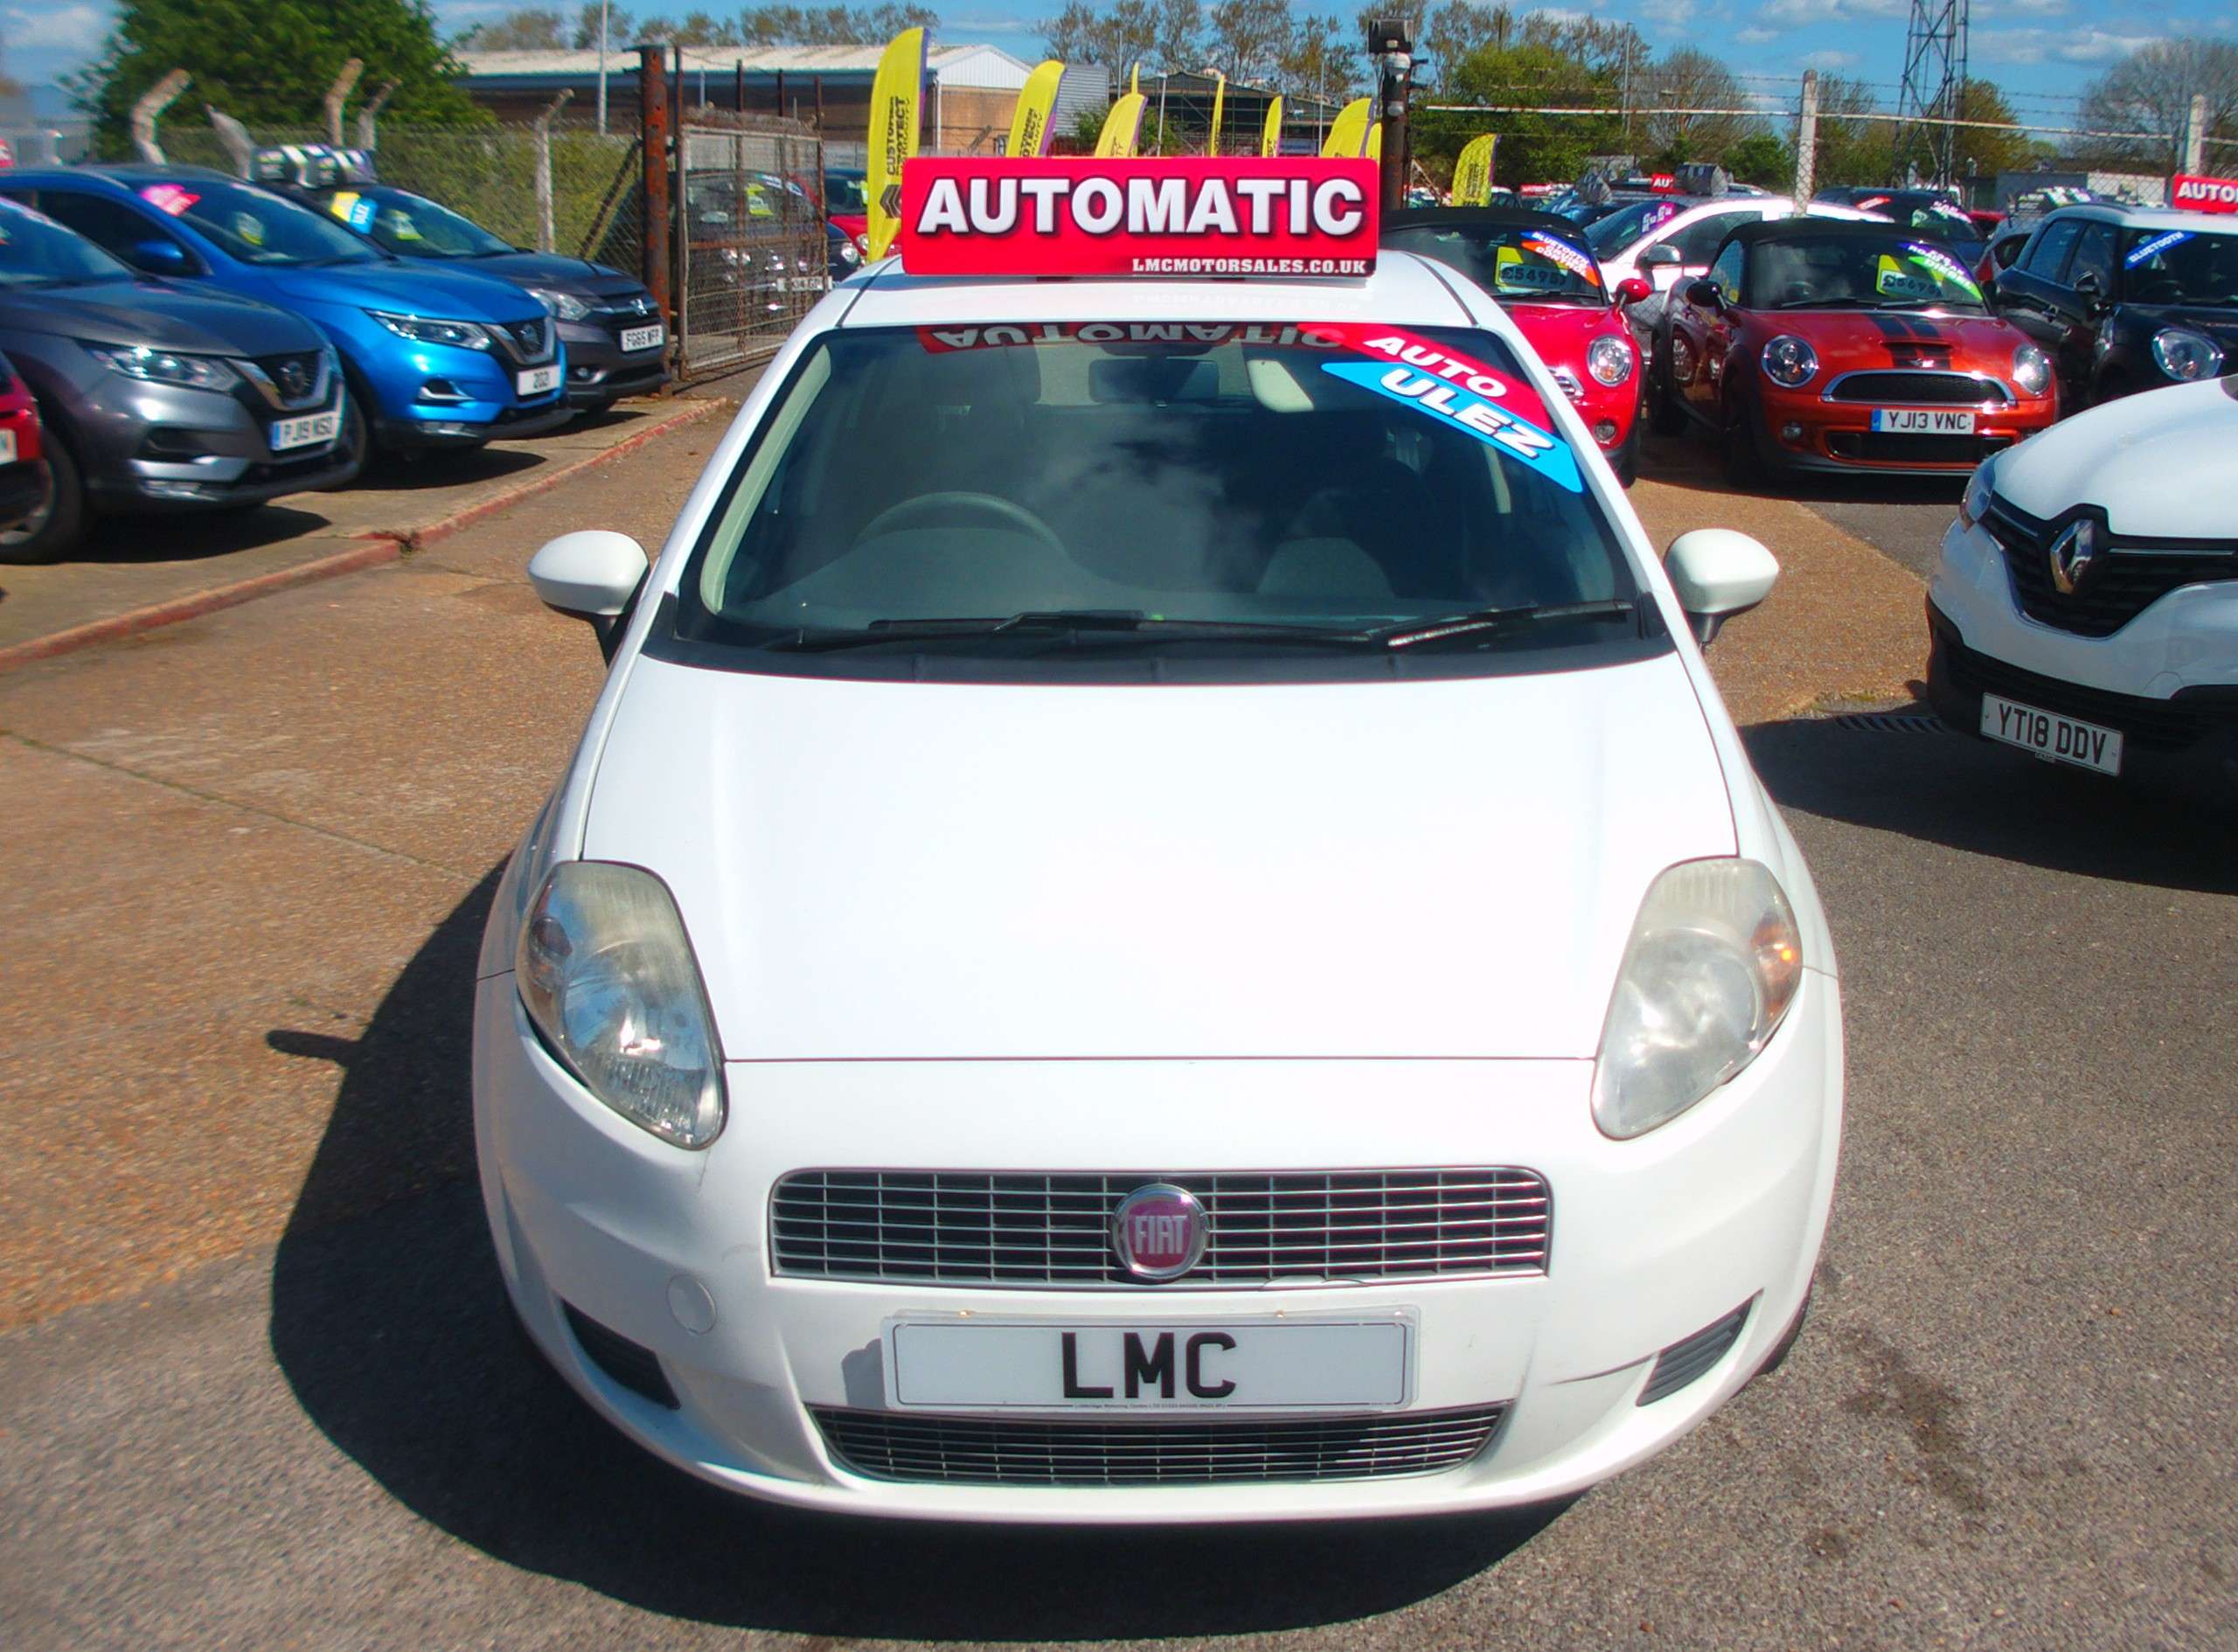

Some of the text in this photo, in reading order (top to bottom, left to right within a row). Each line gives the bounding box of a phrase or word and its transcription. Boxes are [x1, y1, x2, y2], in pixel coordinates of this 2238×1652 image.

[917, 177, 1363, 235] AUTOMATIC
[2176, 181, 2238, 203] AUTO
[1132, 258, 1366, 274] LMCMOTORSALES.CO.UK
[1363, 337, 1507, 397] AUTO
[1380, 368, 1555, 459] ULEZ
[1889, 412, 1968, 430] YJ13 VNC
[1998, 703, 2107, 765] YT18 DDV
[1135, 1215, 1188, 1255] FIAT
[1061, 1331, 1237, 1399] LMC
